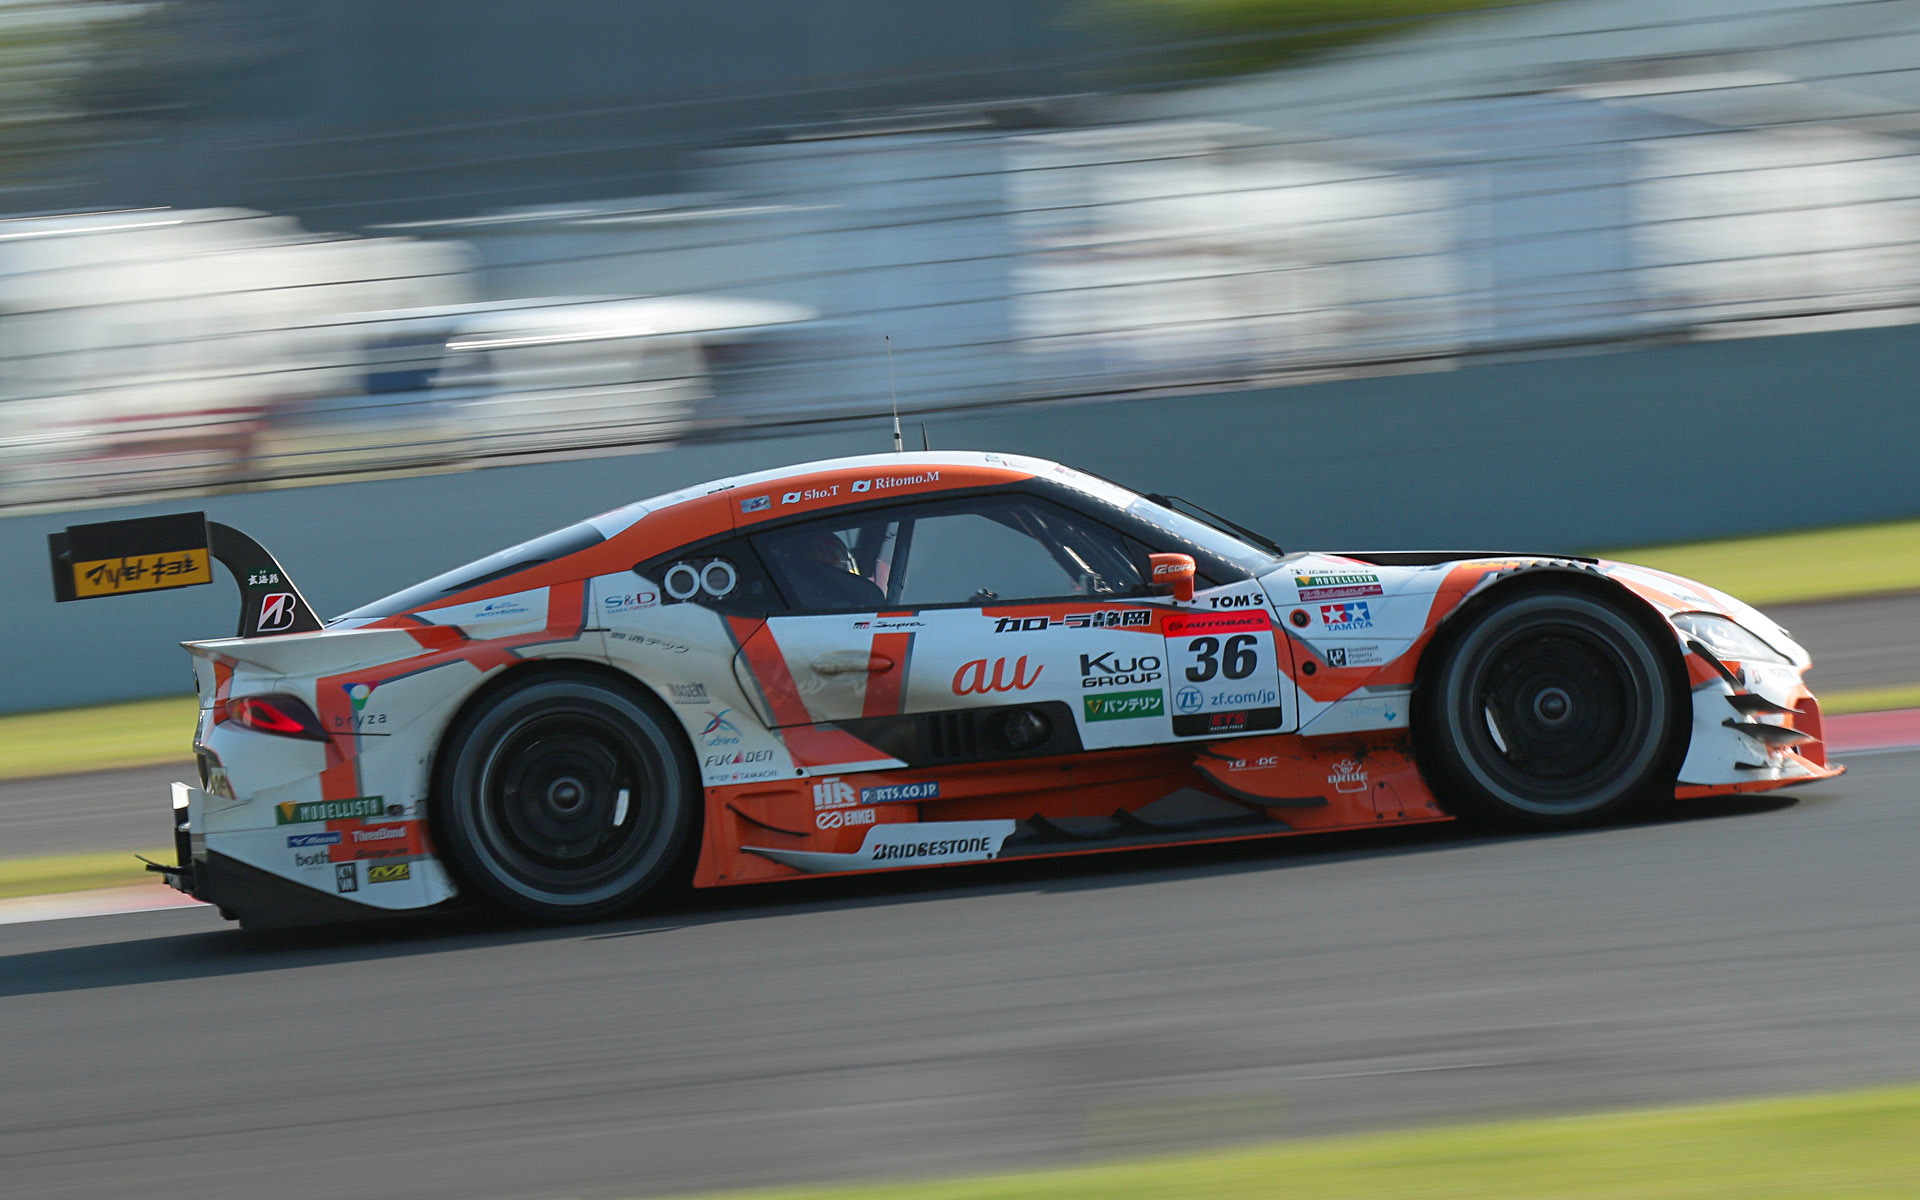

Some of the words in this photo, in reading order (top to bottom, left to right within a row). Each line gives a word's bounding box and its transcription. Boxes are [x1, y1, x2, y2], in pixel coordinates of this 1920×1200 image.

[875, 471, 940, 490] Ritomo.M
[804, 485, 840, 501] Sho.T
[1316, 575, 1374, 585] MODELLISTA
[605, 592, 656, 609] S&D
[994, 610, 1152, 633] カローラ静岡
[1186, 618, 1265, 629] AUTOBACS
[1325, 620, 1374, 632] TAMIYA
[1185, 634, 1258, 683] 36
[953, 655, 1044, 697] au
[1082, 672, 1162, 688] GROUP
[1103, 697, 1161, 714] バンテリン
[1211, 689, 1276, 706] zf.com/jp
[1212, 712, 1246, 726] ETS
[740, 771, 777, 779] TAMACHI
[1328, 772, 1368, 784] BRIDE
[300, 800, 378, 820] MODELLISTA
[844, 809, 876, 826] ENKEI
[351, 827, 407, 842] ThreeBond
[872, 837, 991, 861] BRIDGESTONE
